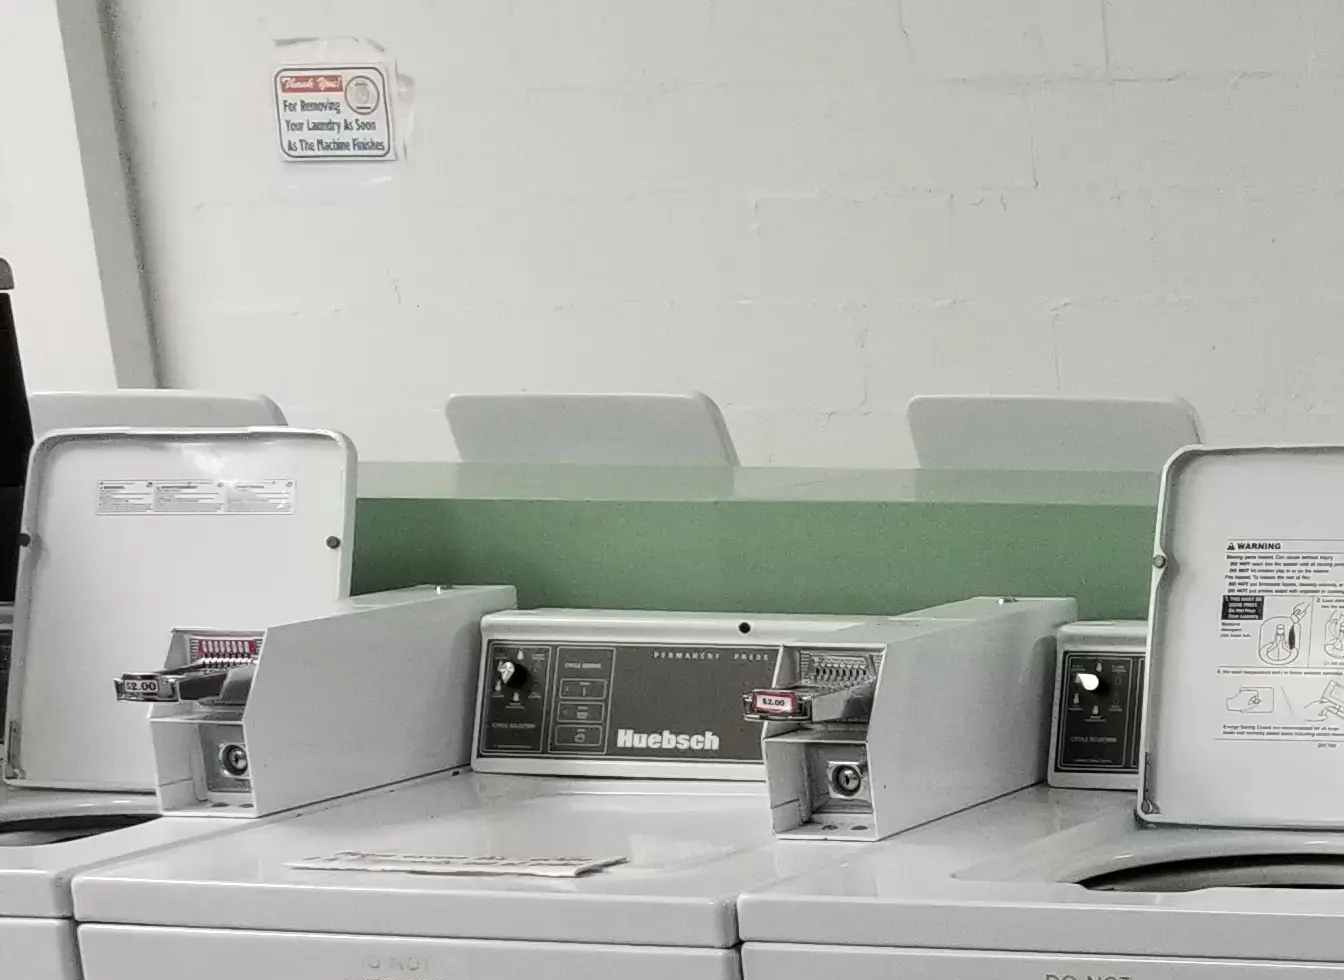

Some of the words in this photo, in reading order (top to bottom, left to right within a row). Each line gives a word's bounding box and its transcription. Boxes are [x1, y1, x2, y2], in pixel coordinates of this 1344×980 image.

[283, 100, 297, 112] For
[300, 99, 341, 114] Removing
[285, 119, 304, 132] Your
[307, 119, 341, 134] Laundry
[344, 119, 354, 131] As
[355, 119, 376, 131] Soon
[288, 140, 297, 151] As
[300, 138, 315, 151] The
[317, 138, 350, 151] Machine
[352, 138, 385, 151] Finishes
[653, 651, 720, 660] PERMANENT
[734, 653, 769, 661] PRESS
[617, 729, 720, 750] Huebsch
